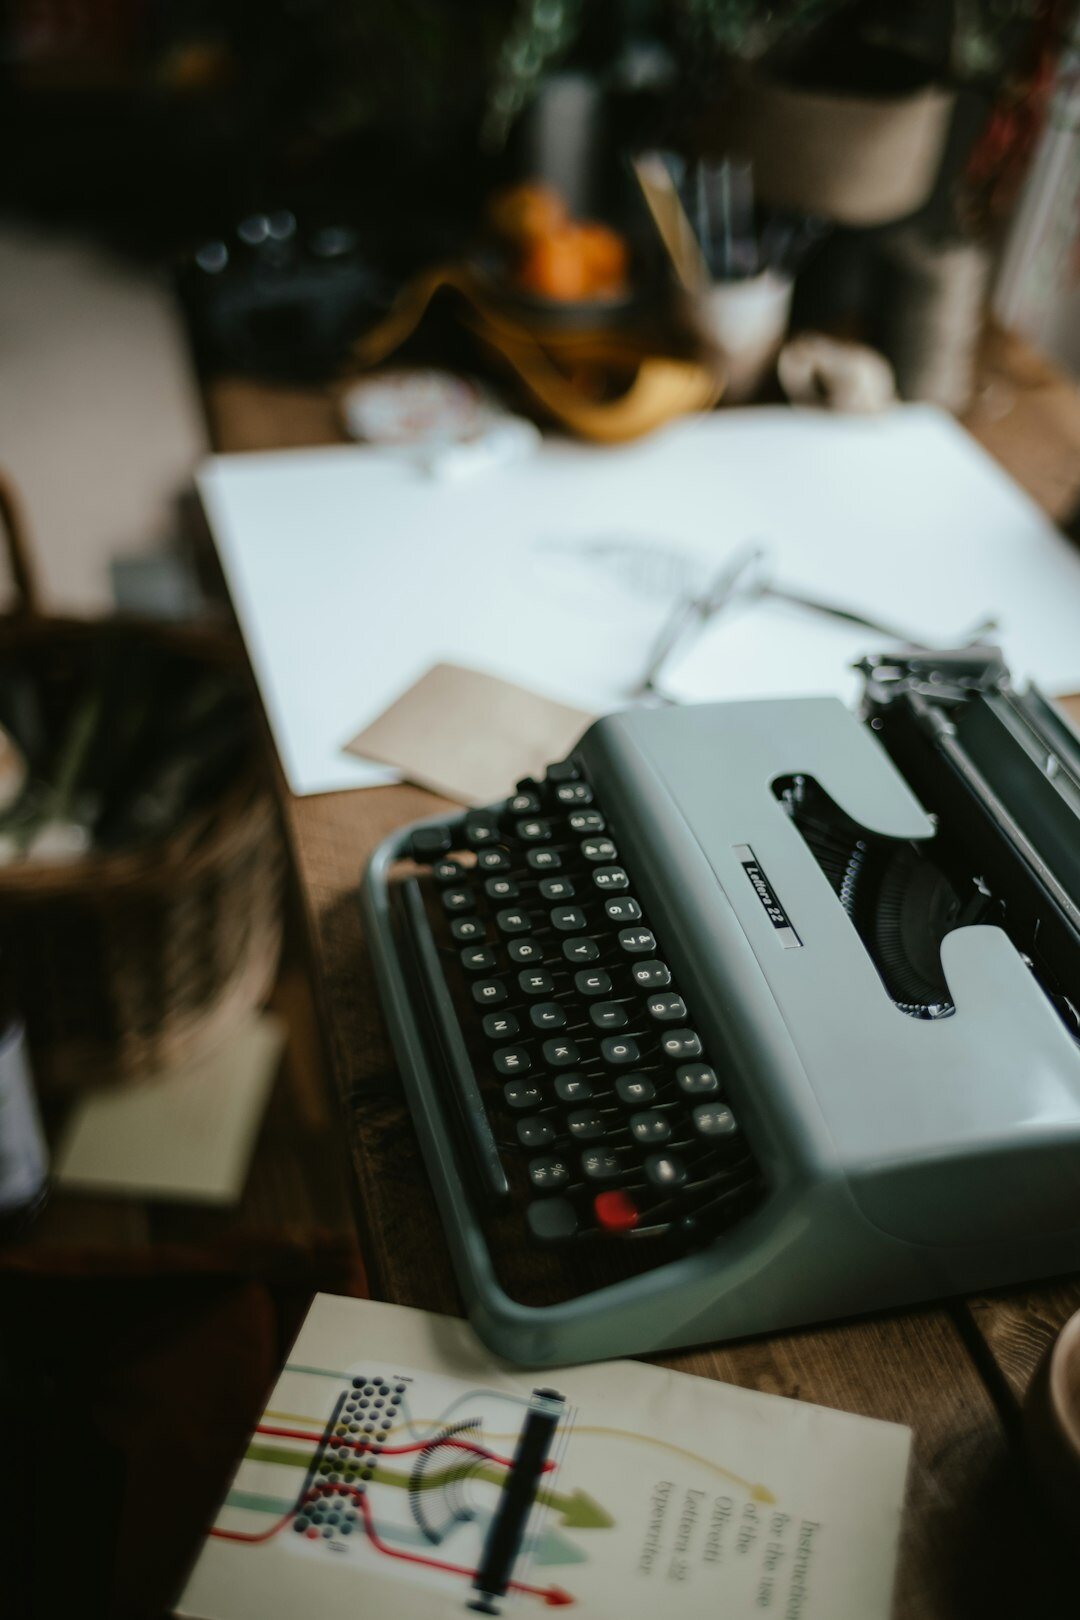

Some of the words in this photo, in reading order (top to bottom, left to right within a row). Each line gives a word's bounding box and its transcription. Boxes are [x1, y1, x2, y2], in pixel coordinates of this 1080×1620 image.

[746, 867, 772, 905] Lettera
[767, 907, 784, 922] 22
[637, 1480, 675, 1577] typewriter
[674, 1488, 706, 1554] Lettera
[742, 1501, 761, 1525] of
[770, 1511, 791, 1539] for
[703, 1496, 735, 1563] Olivetti
[734, 1525, 757, 1555] the
[761, 1541, 785, 1572] the
[756, 1576, 776, 1608] use
